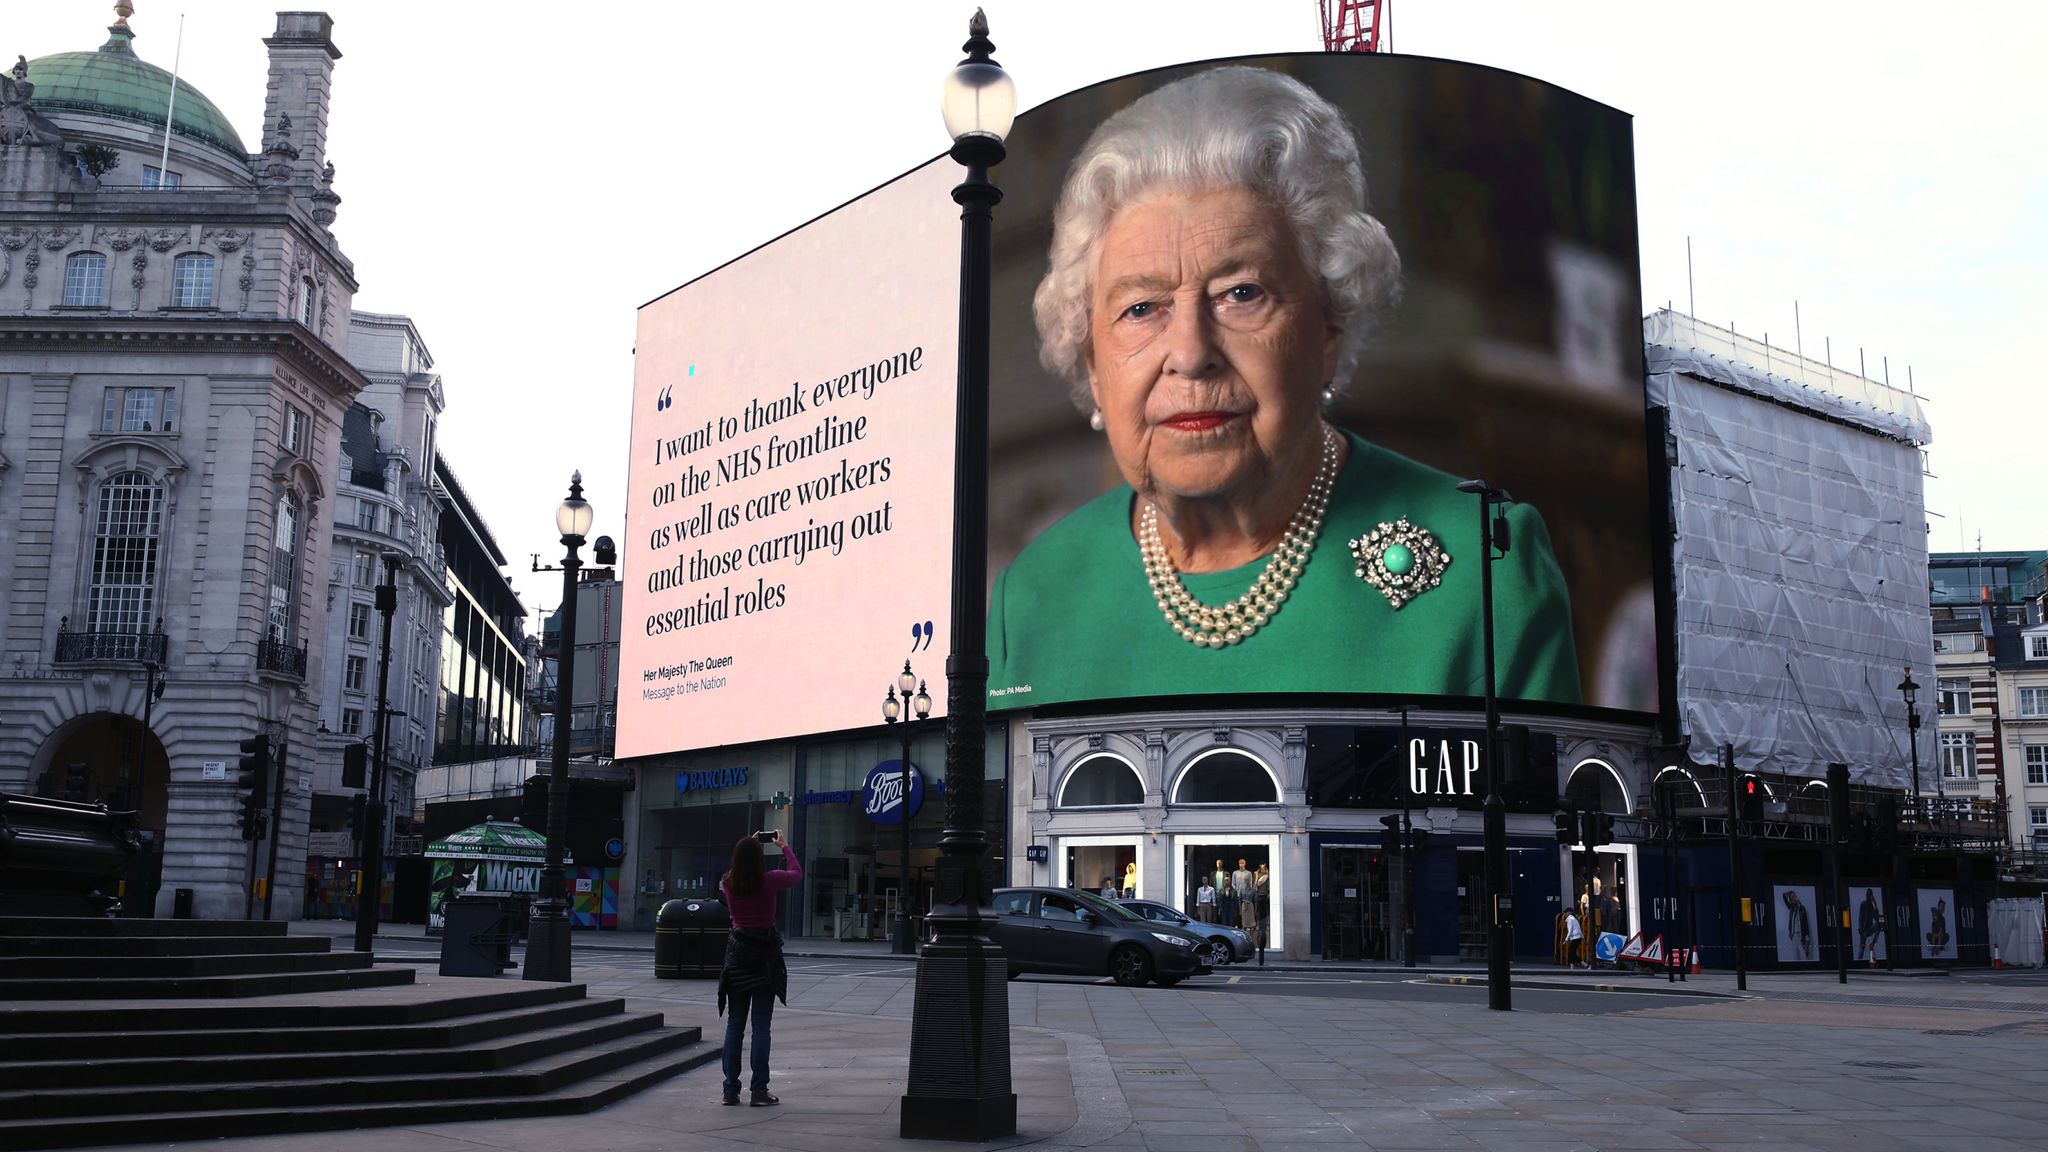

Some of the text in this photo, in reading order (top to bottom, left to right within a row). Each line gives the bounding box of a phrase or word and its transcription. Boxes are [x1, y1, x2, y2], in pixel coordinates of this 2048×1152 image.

[276, 366, 325, 410] ALLIANCE LIFE OFFICE
[654, 346, 923, 466] I want to thank everyone
[652, 416, 867, 508] on the NHS frontline
[650, 456, 891, 551] as well as care workers
[648, 501, 893, 594] and those carrying out
[645, 577, 786, 637] essential roles
[643, 655, 733, 683] Her Majesty The Queen
[642, 677, 726, 701] Message to the Nation
[989, 689, 1006, 697] Photo:
[1015, 684, 1032, 693] Media
[689, 767, 748, 791] BARCLAYS
[1409, 738, 1479, 796] GAP
[801, 790, 853, 807] pharmacy
[1750, 903, 1766, 927] AP
[1826, 904, 1838, 927] GA
[1896, 904, 1911, 928] GAP
[1960, 906, 1975, 929] GAP
